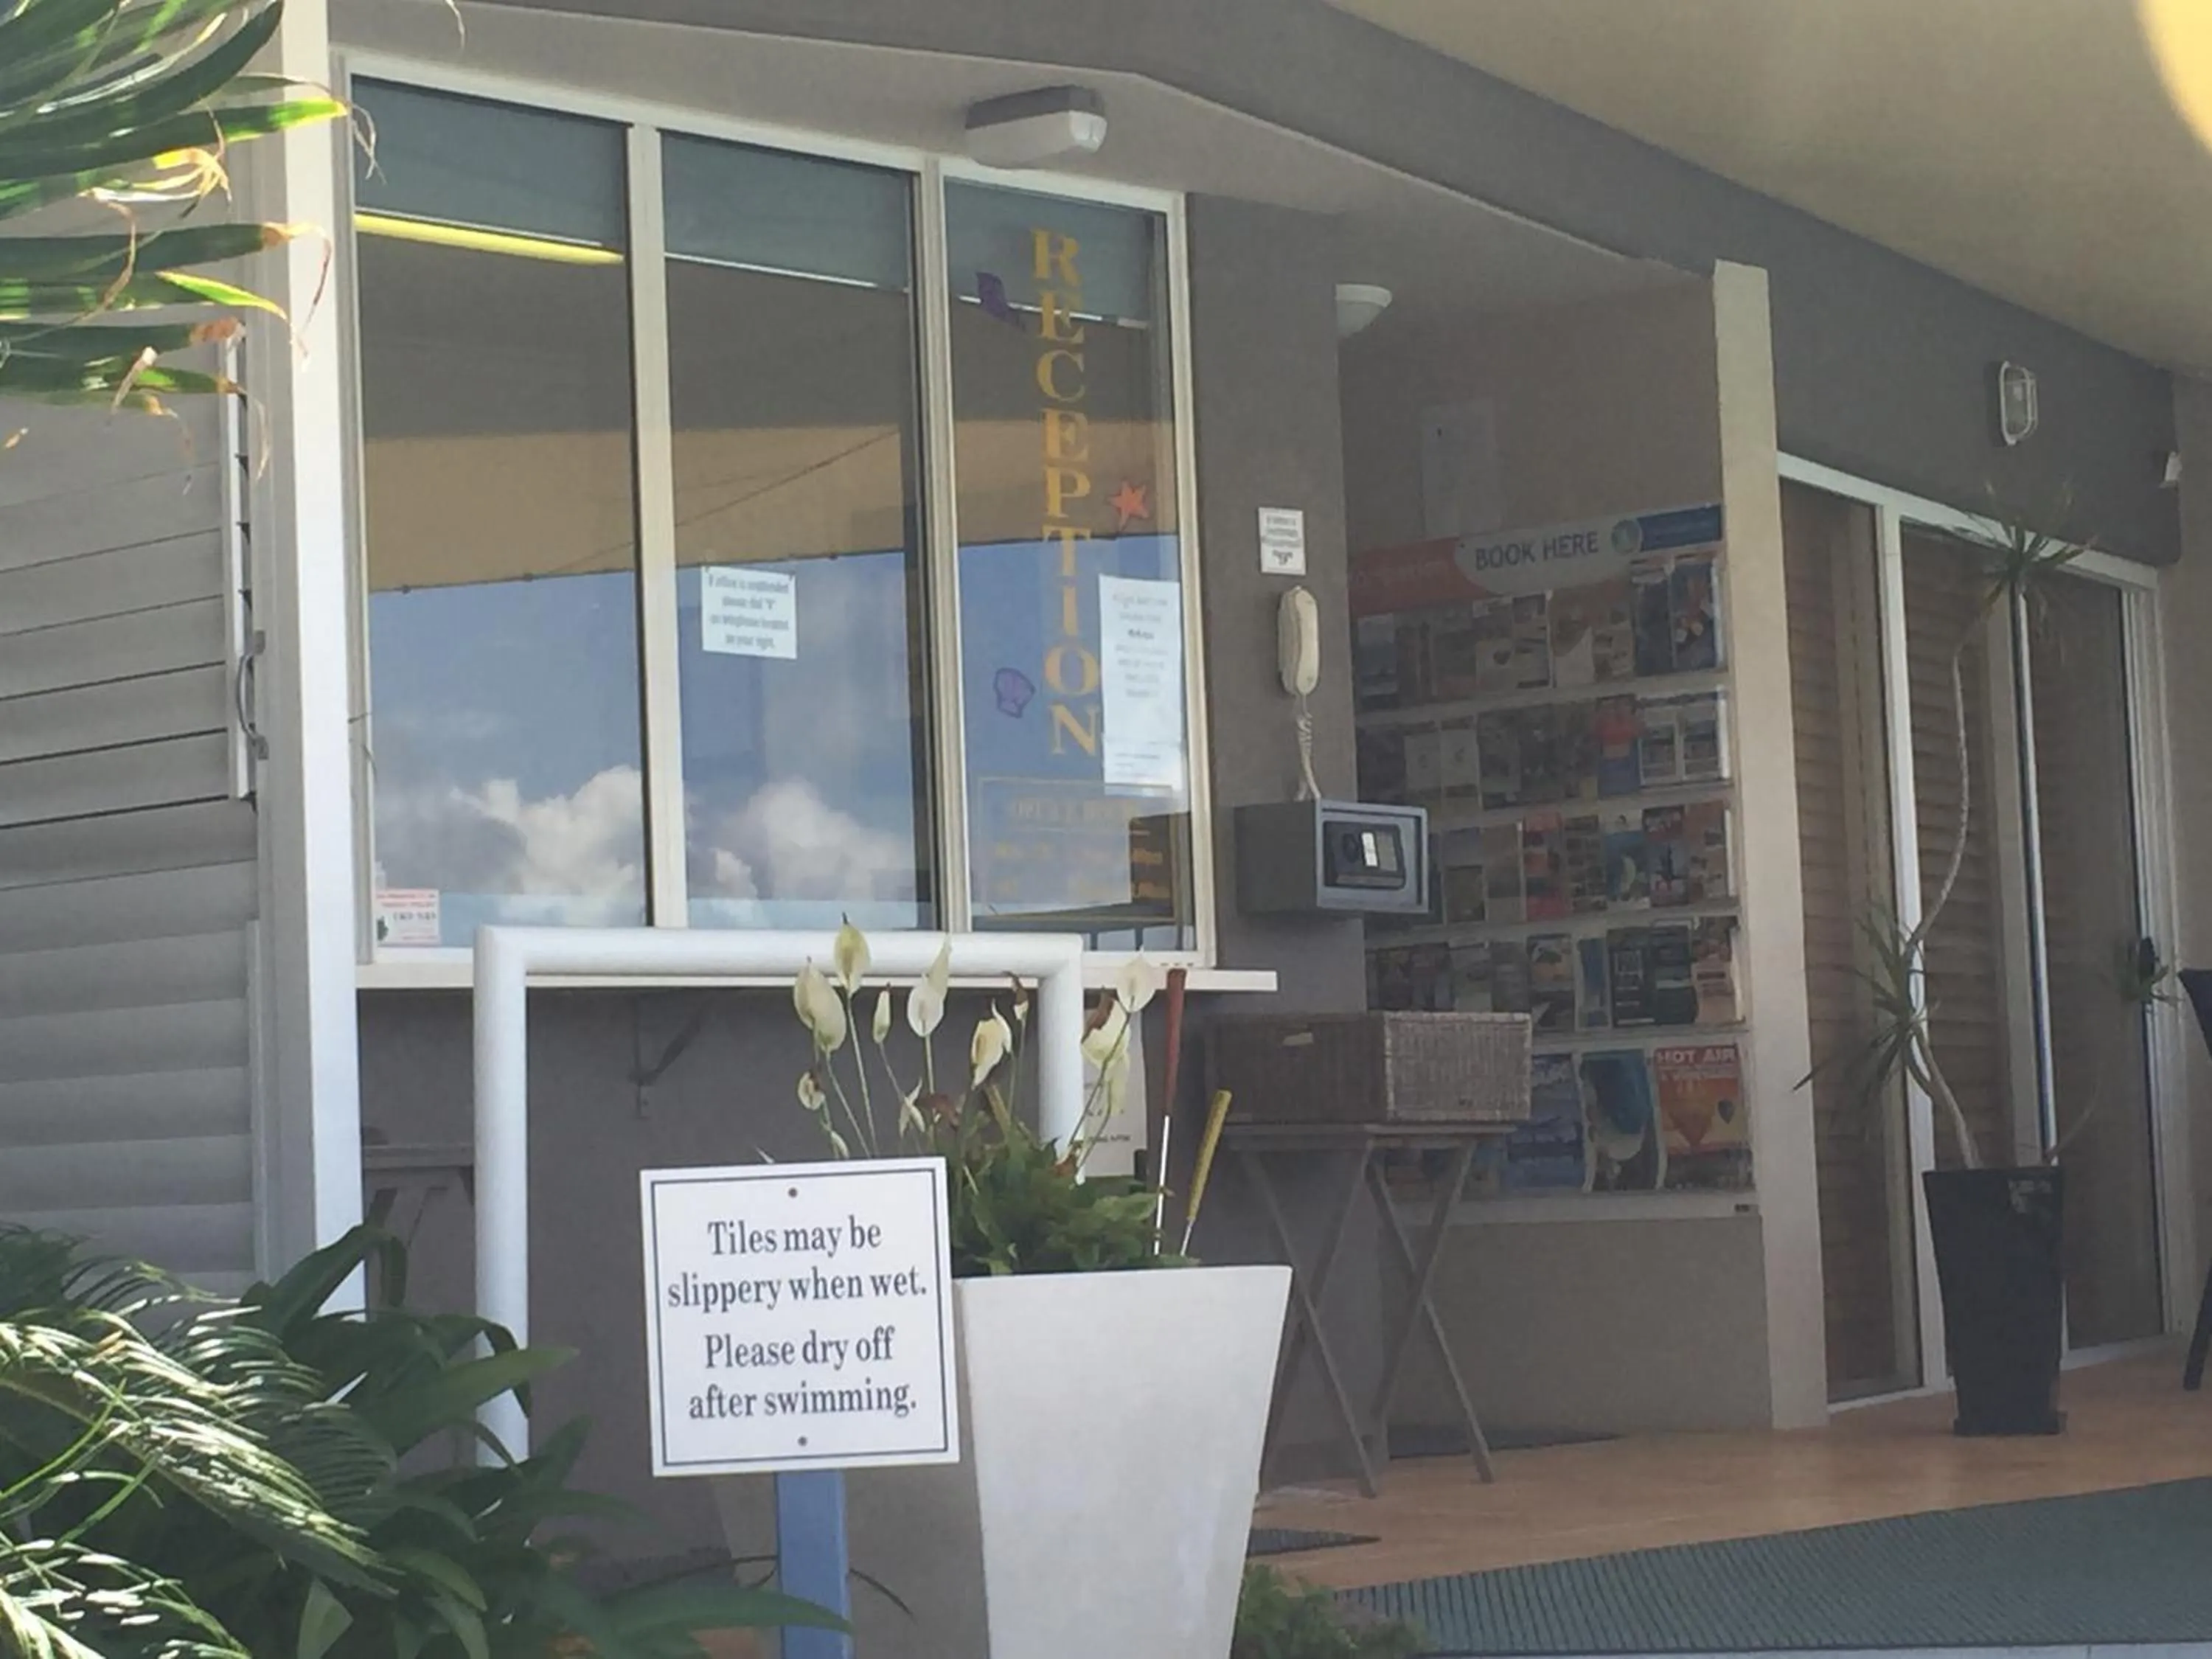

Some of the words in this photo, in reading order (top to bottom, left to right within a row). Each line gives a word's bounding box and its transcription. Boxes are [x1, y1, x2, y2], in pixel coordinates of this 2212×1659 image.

[1032, 227, 1100, 757] RECEPTION
[1475, 540, 1537, 571] BOOK
[1543, 531, 1599, 561] HERE
[1658, 1049, 1695, 1064] HOT
[1703, 1048, 1736, 1062] AIR
[708, 1220, 777, 1256] Tiles
[783, 1225, 842, 1258] may
[849, 1215, 882, 1249] be
[667, 1272, 782, 1313] slippery
[789, 1265, 863, 1301] when
[870, 1265, 928, 1296] wet.
[704, 1333, 796, 1369] Please
[802, 1329, 849, 1371] dry
[855, 1325, 896, 1361] off
[689, 1383, 758, 1419] after
[764, 1377, 917, 1418] swimming.
